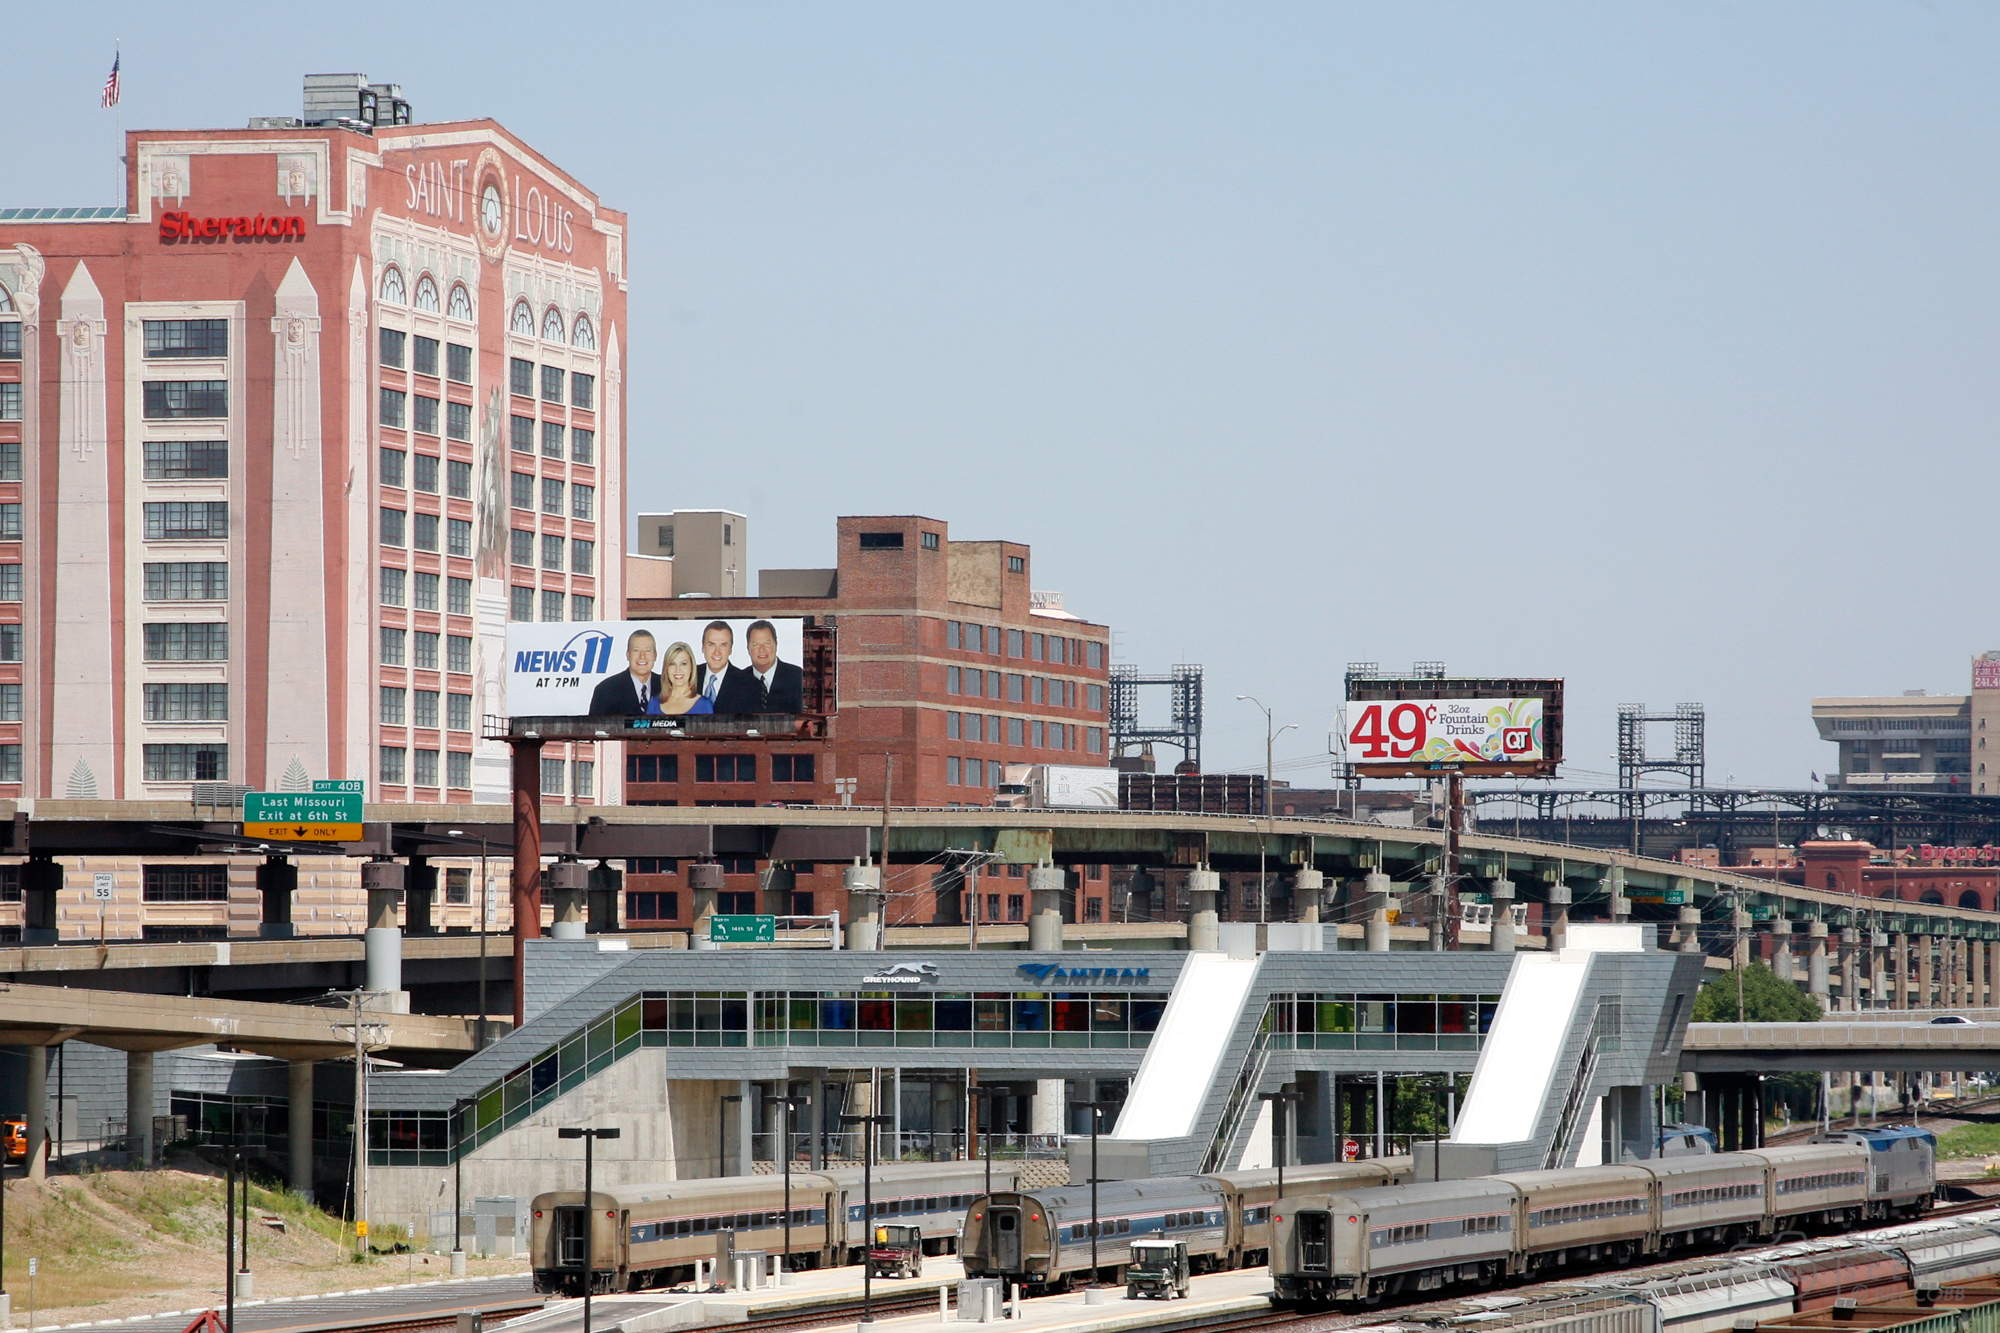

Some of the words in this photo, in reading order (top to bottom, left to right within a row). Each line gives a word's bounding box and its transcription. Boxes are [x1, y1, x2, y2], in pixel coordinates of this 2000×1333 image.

[406, 158, 471, 224] SAINT
[515, 174, 575, 255] LOUIS
[159, 210, 306, 239] Sheraton
[514, 650, 577, 673] NEWS
[581, 636, 614, 674] 11
[535, 677, 551, 688] AT
[555, 677, 580, 688] 7PM
[1448, 704, 1471, 714] 32oz
[1439, 713, 1489, 725] Fountain
[1446, 724, 1485, 735] Drinks
[1505, 731, 1528, 750] QT
[338, 781, 361, 791] 40B
[262, 797, 288, 807] Last
[294, 797, 345, 807] Missouri
[259, 811, 284, 821] Exit
[289, 812, 302, 821] at
[308, 811, 329, 821] 6th
[335, 811, 348, 821] St
[314, 828, 337, 836] ONLY
[1920, 843, 1977, 860] BUSCH
[96, 888, 109, 897] 55
[1054, 967, 1150, 978] AMTRAK
[863, 976, 921, 984] GREYHOUND
